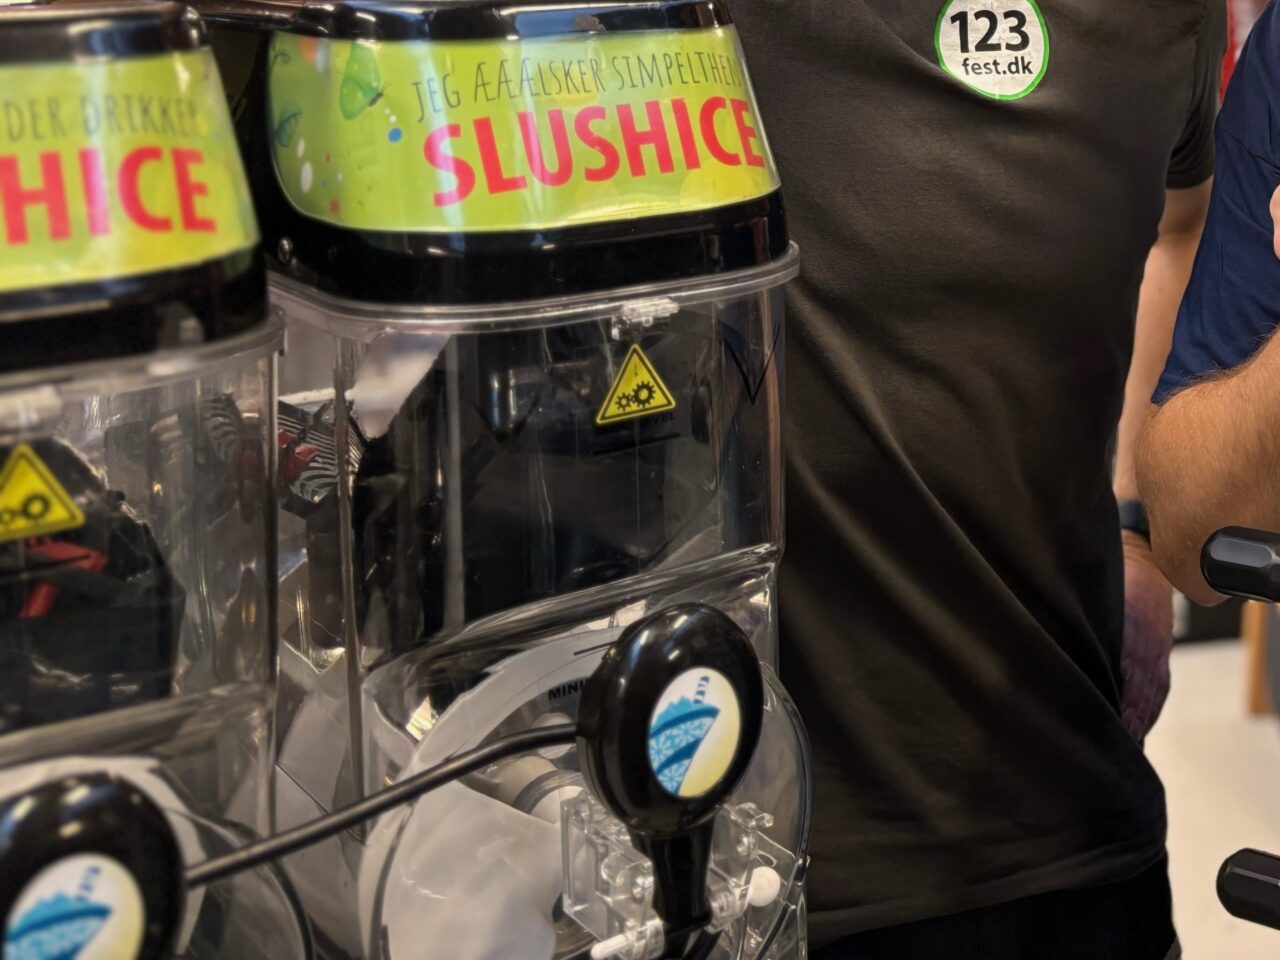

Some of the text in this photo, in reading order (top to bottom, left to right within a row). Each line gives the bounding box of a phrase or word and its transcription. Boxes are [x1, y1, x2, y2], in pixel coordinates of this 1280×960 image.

[950, 9, 1030, 53] 123
[411, 73, 461, 123] JEG
[611, 51, 743, 90] SIMPELTHEN
[961, 56, 1034, 75] fest.dk
[4, 96, 66, 141] DER
[423, 95, 765, 207] SLUSHICE
[0, 145, 217, 245] HICE
